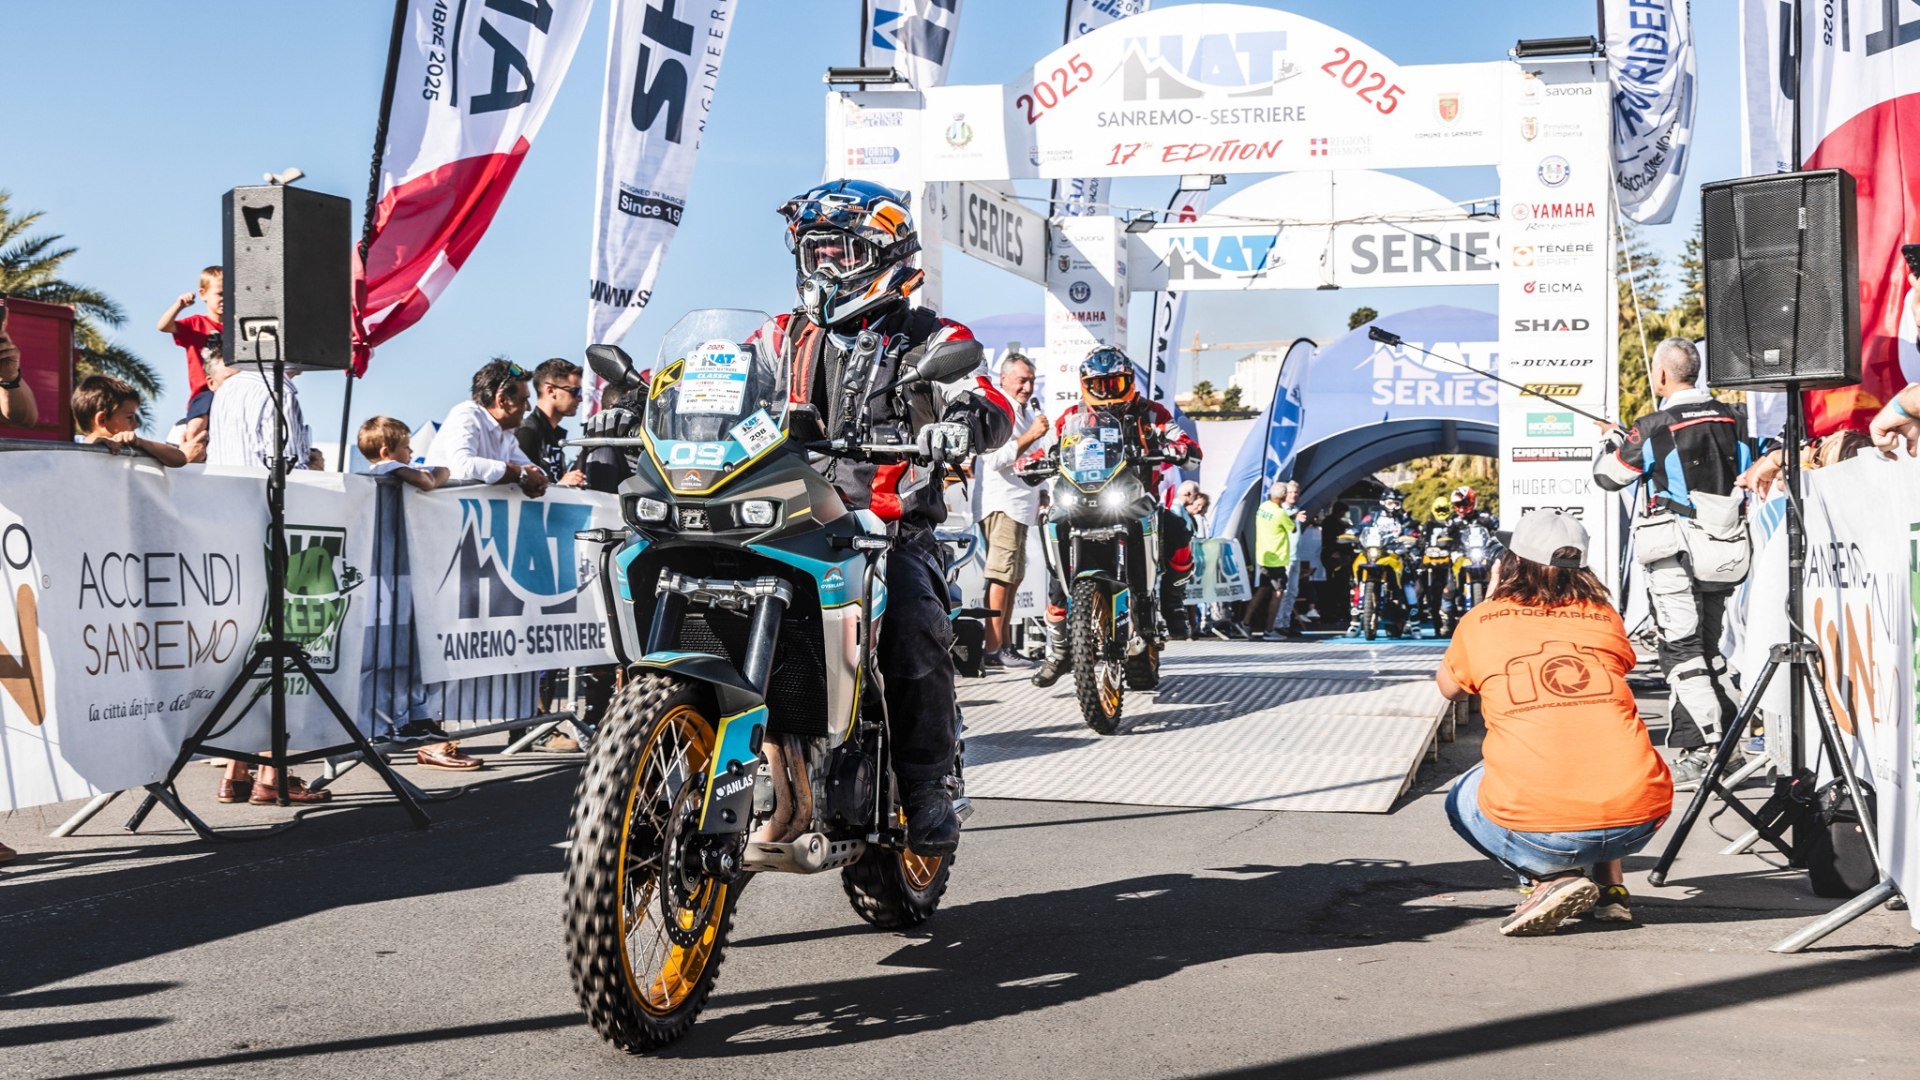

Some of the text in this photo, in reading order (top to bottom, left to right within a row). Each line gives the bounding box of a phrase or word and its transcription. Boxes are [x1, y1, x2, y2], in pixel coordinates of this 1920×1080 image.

[1823, 0, 1834, 47] 025
[422, 50, 446, 101] 2025
[1321, 47, 1405, 115] 2025
[1016, 53, 1093, 125] 2025
[1545, 87, 1592, 96] savona
[1162, 140, 1284, 163] EDITION
[620, 195, 681, 222] Since 19
[1531, 203, 1595, 218] YAMAHA
[969, 193, 1023, 266] SERIES
[1351, 232, 1499, 275] SERIE
[1539, 283, 1583, 293] EICMA
[1066, 311, 1106, 321] YAMAHA
[1515, 319, 1590, 332] SHAD
[1522, 359, 1593, 367] DUNLOP
[1056, 392, 1083, 400] SH
[1372, 379, 1499, 406] SERIES
[1523, 384, 1580, 396] Klim
[671, 444, 726, 465] 09
[1081, 470, 1100, 480] 10
[1512, 479, 1591, 495] HUGEROCK
[79, 552, 241, 610] ACCENDI
[821, 581, 845, 589] OVERLAND
[1480, 608, 1612, 624] PHOTOGRAPHER
[83, 619, 238, 676] SANREMO
[437, 622, 607, 662] ANREMO-SESTRIERE
[89, 704, 100, 721] la
[103, 702, 127, 719] città
